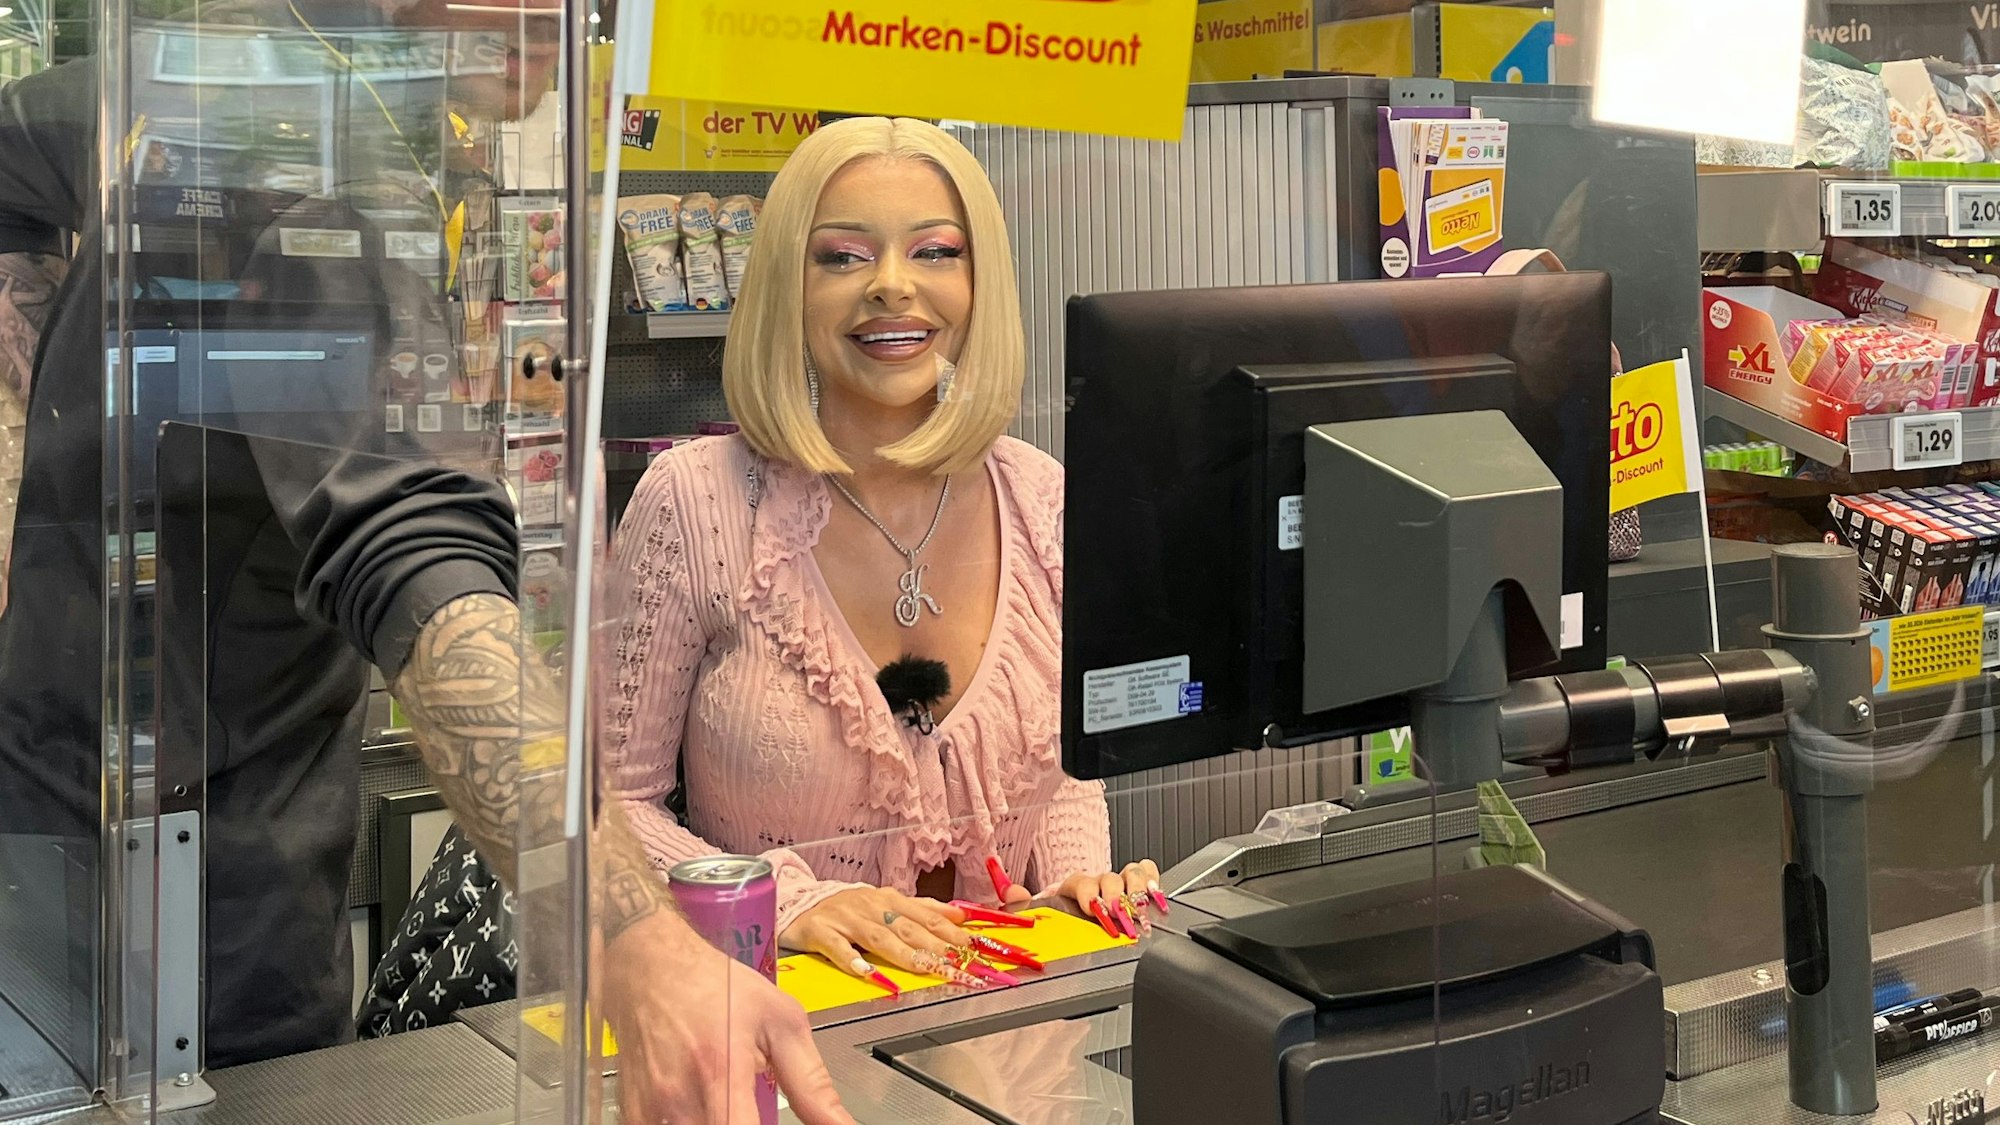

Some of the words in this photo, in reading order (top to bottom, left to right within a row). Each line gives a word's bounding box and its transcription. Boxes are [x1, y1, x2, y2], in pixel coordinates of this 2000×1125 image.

[1207, 8, 1309, 41] Waschmittel
[1970, 3, 2000, 30] Vi
[821, 10, 1142, 67] Marken-Discount
[1804, 18, 1871, 44] twein
[703, 110, 745, 134] der
[751, 111, 786, 135] TV
[639, 207, 669, 220] DRAIN
[1854, 199, 1892, 221] 1.35
[639, 215, 674, 234] FREE
[1441, 211, 1481, 236] Netto
[1739, 342, 1776, 375] XL
[1729, 370, 1773, 385] ENERGY
[1610, 401, 1664, 464] to
[1916, 428, 1953, 452] 1.29
[1983, 628, 1999, 642] .95
[1440, 1060, 1590, 1125] Magellan
